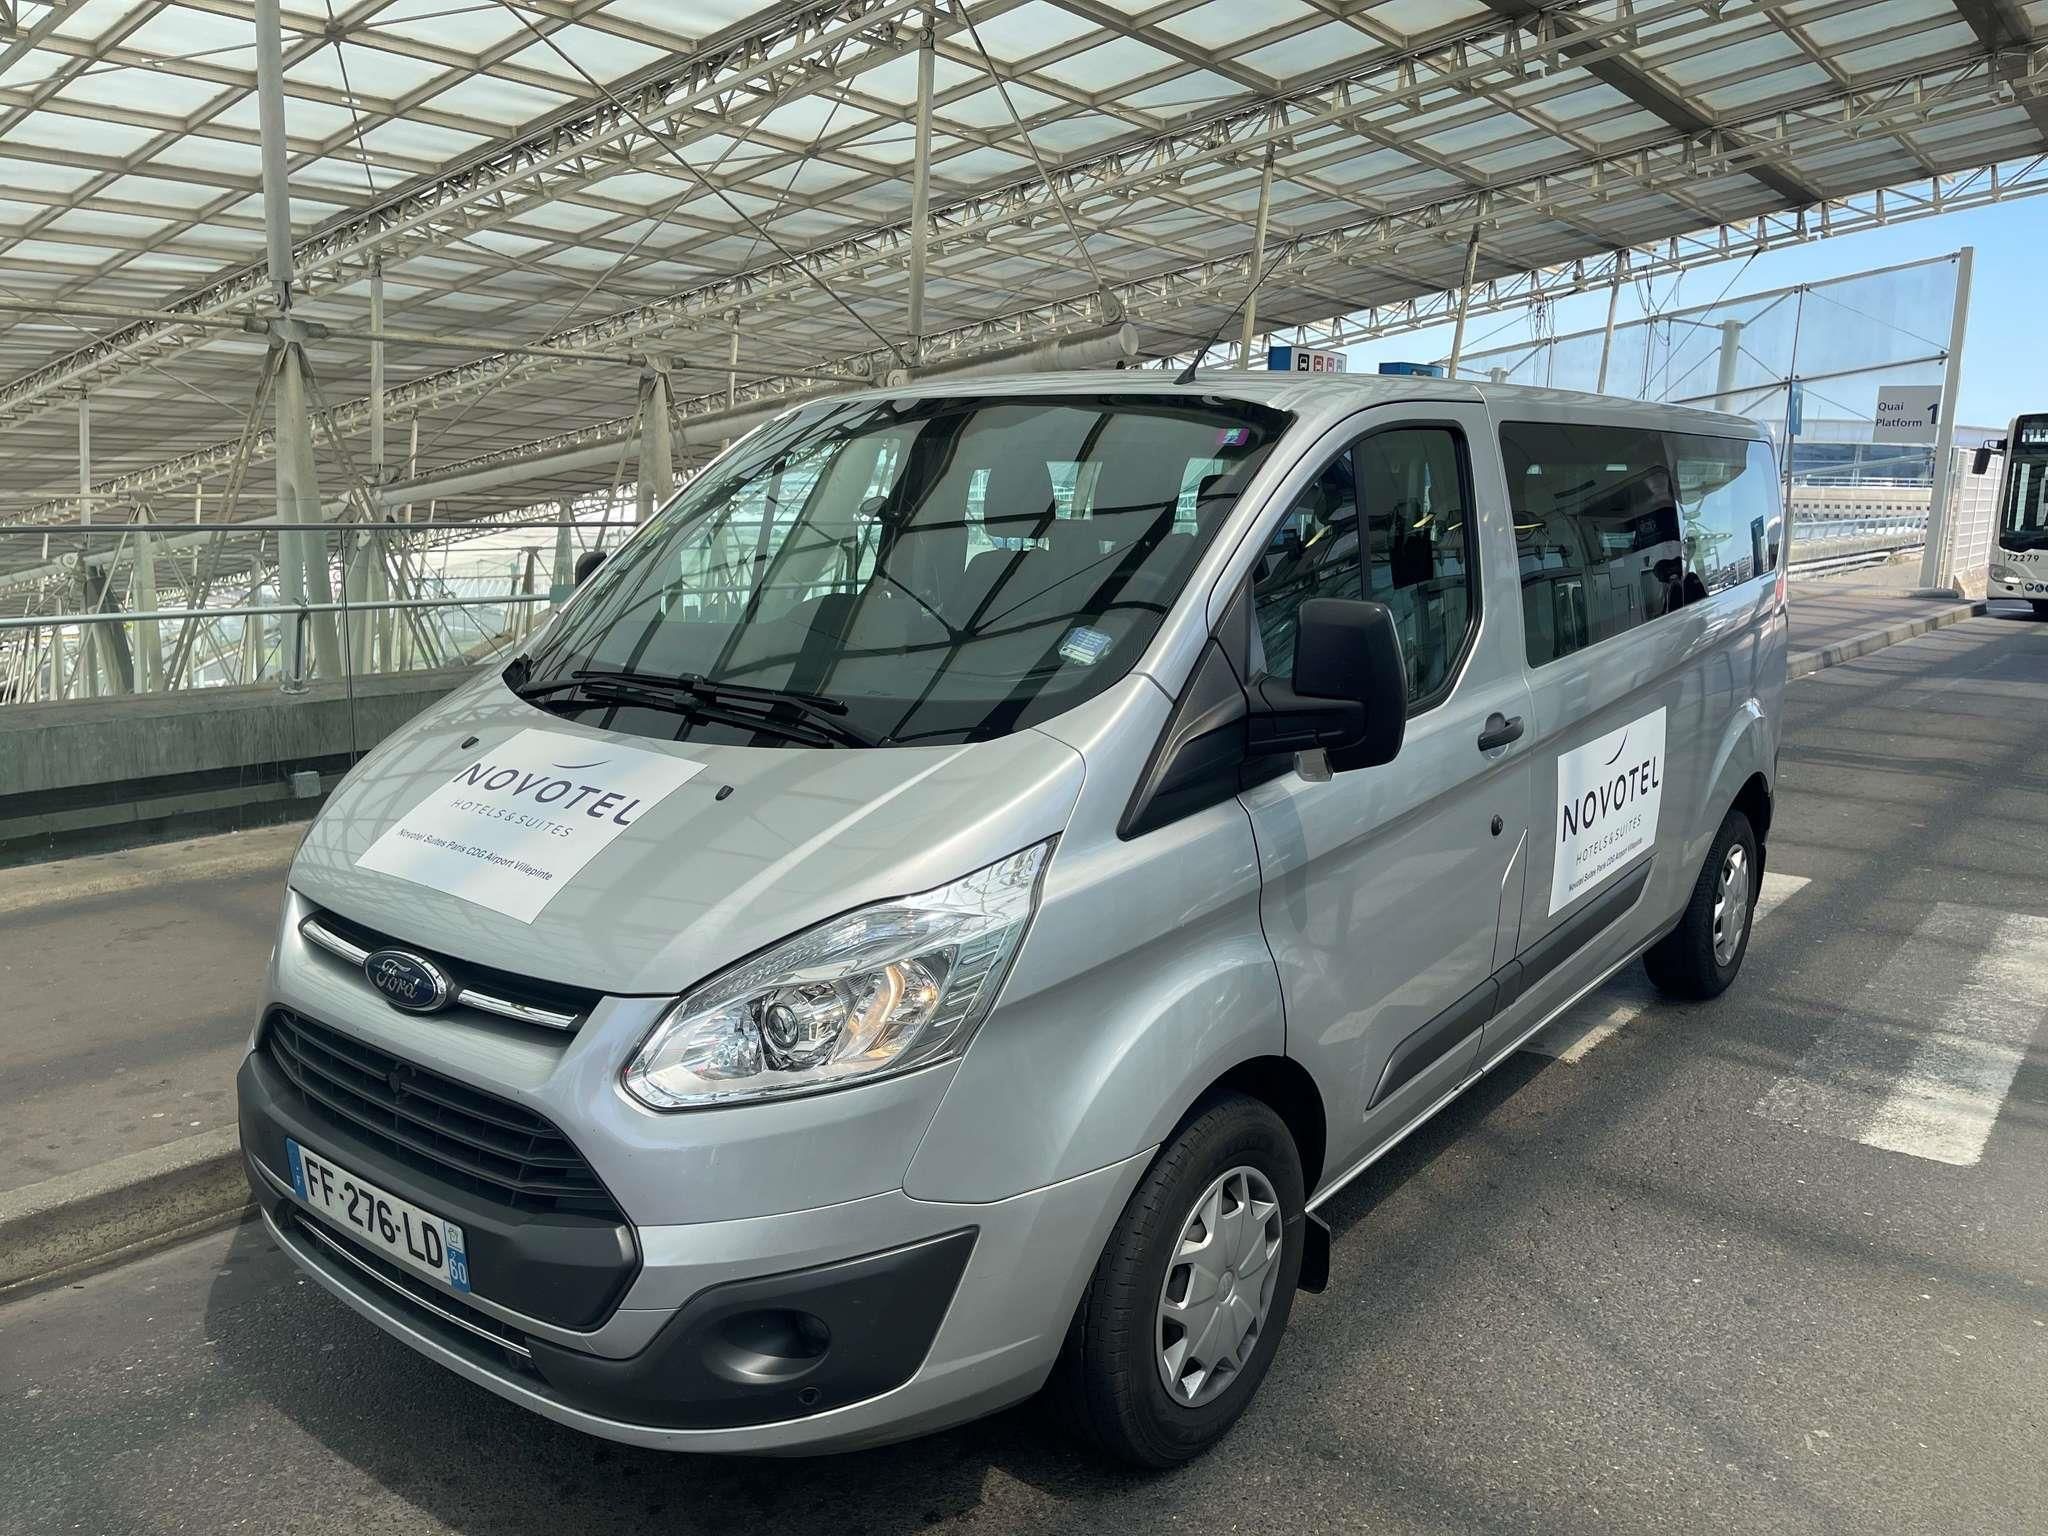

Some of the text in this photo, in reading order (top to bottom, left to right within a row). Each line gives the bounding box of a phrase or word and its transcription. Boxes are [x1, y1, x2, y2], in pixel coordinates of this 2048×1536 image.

[1875, 418, 1922, 427] Platform
[1878, 402, 1904, 411] Quai
[1927, 403, 1938, 424] 1
[2007, 554, 2040, 562] 72279
[452, 762, 642, 826] NOVOTEL
[1562, 756, 1659, 842] NOVOTEL
[446, 841, 466, 853] Paris
[466, 846, 488, 858] CDG
[484, 852, 514, 868] Airport
[513, 860, 553, 881] Villepinte
[376, 959, 420, 999] Ford
[305, 1156, 443, 1269] FF-276-LD
[450, 1258, 467, 1284] 60
